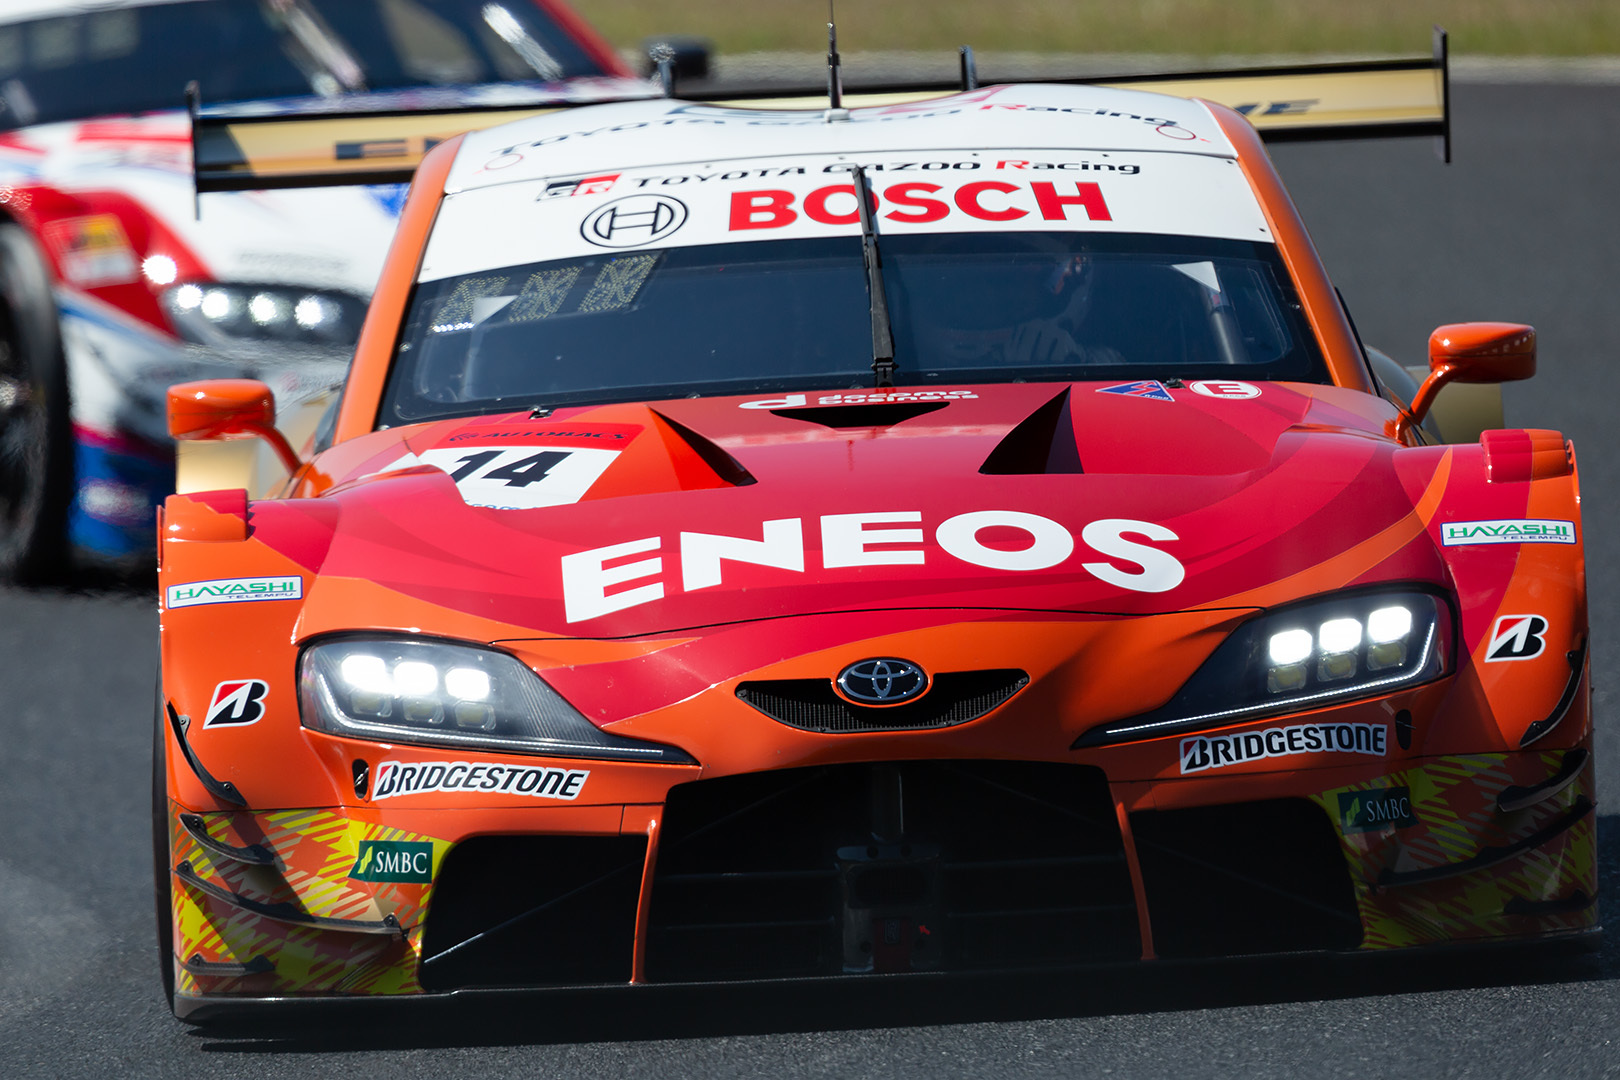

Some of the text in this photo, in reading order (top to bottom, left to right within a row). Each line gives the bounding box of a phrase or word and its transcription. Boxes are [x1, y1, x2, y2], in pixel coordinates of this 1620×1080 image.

[632, 166, 806, 188] TOYOTA
[995, 159, 1141, 175] Racing
[728, 181, 1113, 231] BOSCH
[818, 390, 972, 400] docomo
[450, 450, 574, 488] 14
[1449, 524, 1568, 537] HAYASHI
[560, 510, 1185, 624] ENEOS
[176, 581, 294, 599] HAYASHI
[225, 592, 294, 600] TELEMPU
[1182, 723, 1386, 771] BRIDGESTONE
[375, 763, 586, 798] BRIDGESTONE
[1366, 797, 1410, 822] SMBC
[375, 851, 428, 874] SMBC
